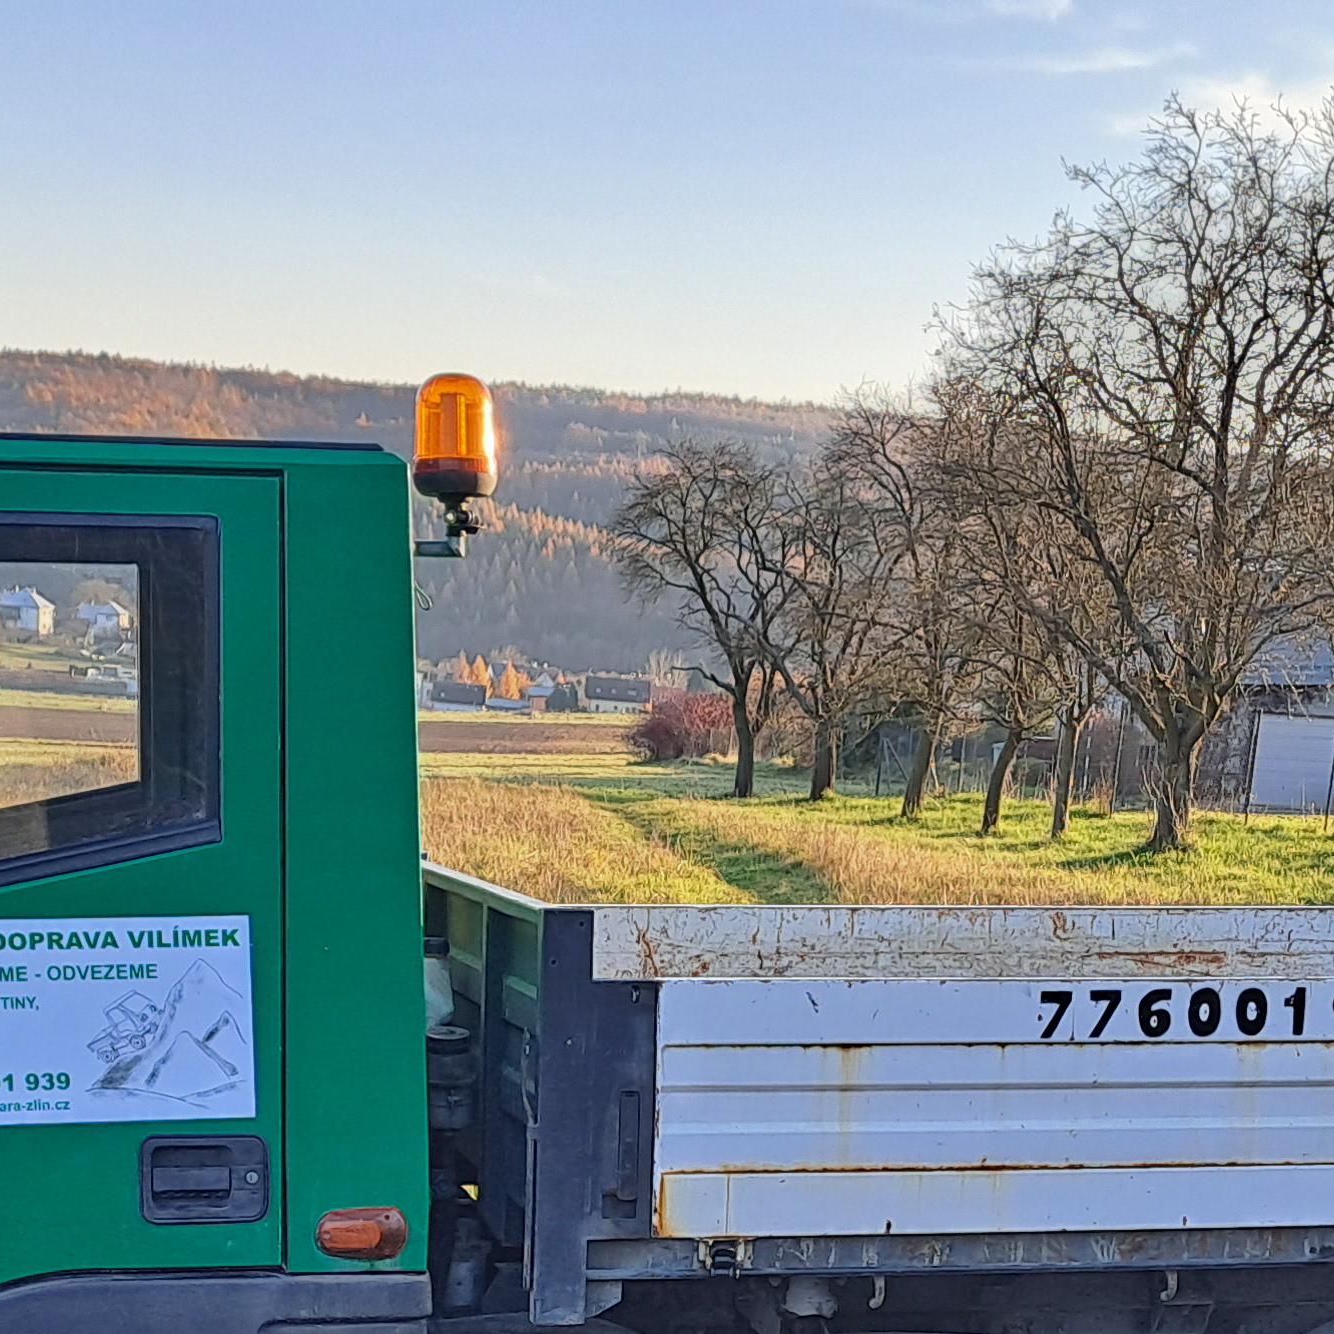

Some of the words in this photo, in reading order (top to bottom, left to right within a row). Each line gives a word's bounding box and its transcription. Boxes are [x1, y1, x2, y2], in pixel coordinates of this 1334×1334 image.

[127, 925, 241, 949] VILÍMEK
[47, 963, 158, 981] ODVEZEME
[25, 1072, 71, 1092] 939
